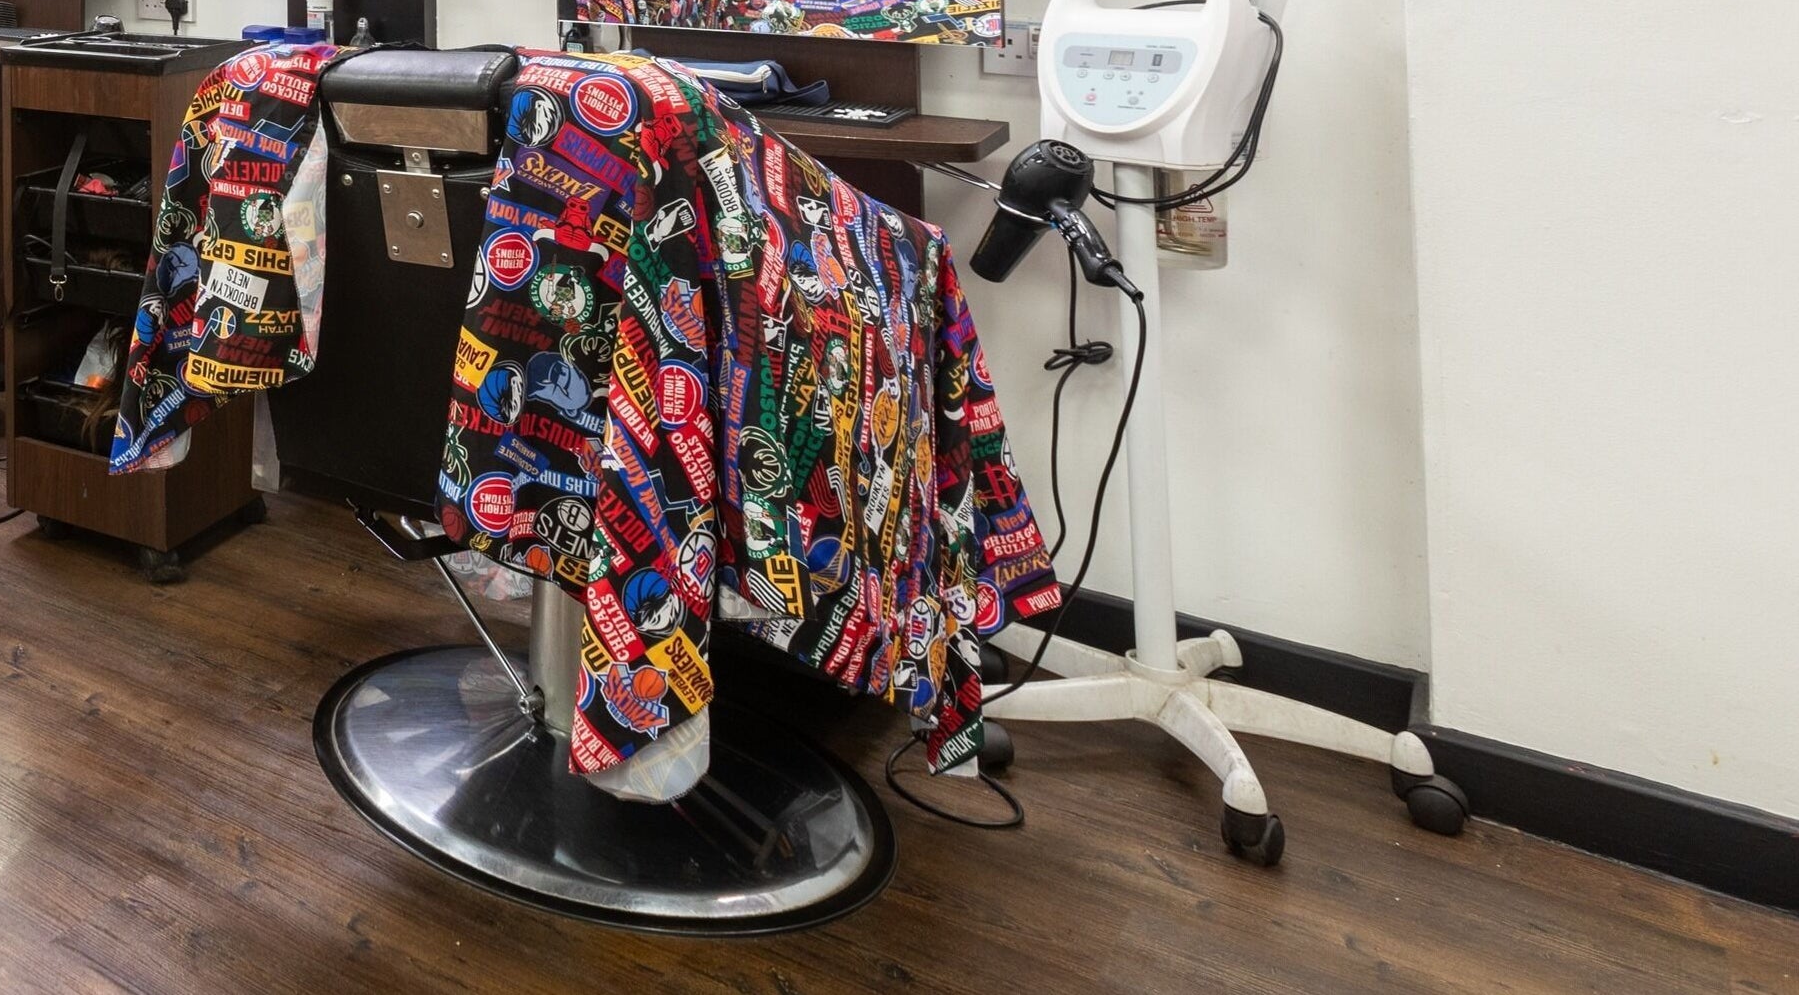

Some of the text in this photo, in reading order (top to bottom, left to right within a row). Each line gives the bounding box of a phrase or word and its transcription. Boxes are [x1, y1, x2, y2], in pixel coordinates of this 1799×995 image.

[273, 71, 311, 94] BULLS
[585, 84, 625, 109] PISTONS
[581, 95, 625, 121] DETROIT
[520, 151, 606, 202] LAKERS
[702, 157, 739, 214] BROOKLYN
[678, 207, 694, 226] NBA
[1197, 216, 1217, 224] TEMP
[494, 247, 526, 259] PISTONS
[494, 258, 526, 270] DETROIT
[226, 268, 250, 289] NETS
[210, 278, 258, 310] BROOKLYN
[528, 269, 594, 324] CELTICS BOSTON
[850, 268, 873, 325] NETS
[258, 324, 294, 334] UTAH
[191, 358, 281, 387] MEMPHIS
[663, 372, 675, 415] DETROIT
[674, 374, 686, 416] PISTONS
[861, 331, 874, 444] DETROIT PISTONS
[611, 394, 654, 449] DETROIT
[969, 417, 992, 433] TRAIL
[671, 432, 712, 501] CHICAGO
[687, 435, 715, 484] BULLS
[479, 493, 515, 505] PISTONS
[864, 463, 886, 523] BROOKLYN
[877, 486, 890, 515] NETS
[479, 504, 515, 515] DETROIT
[995, 513, 1027, 531] New
[536, 511, 593, 557] NETS
[983, 523, 1037, 550] CHICAGO
[993, 536, 1037, 557] BULLS
[993, 550, 1052, 589] LAKERS
[586, 585, 630, 662] CHICAGO
[600, 592, 637, 644] BULLS
